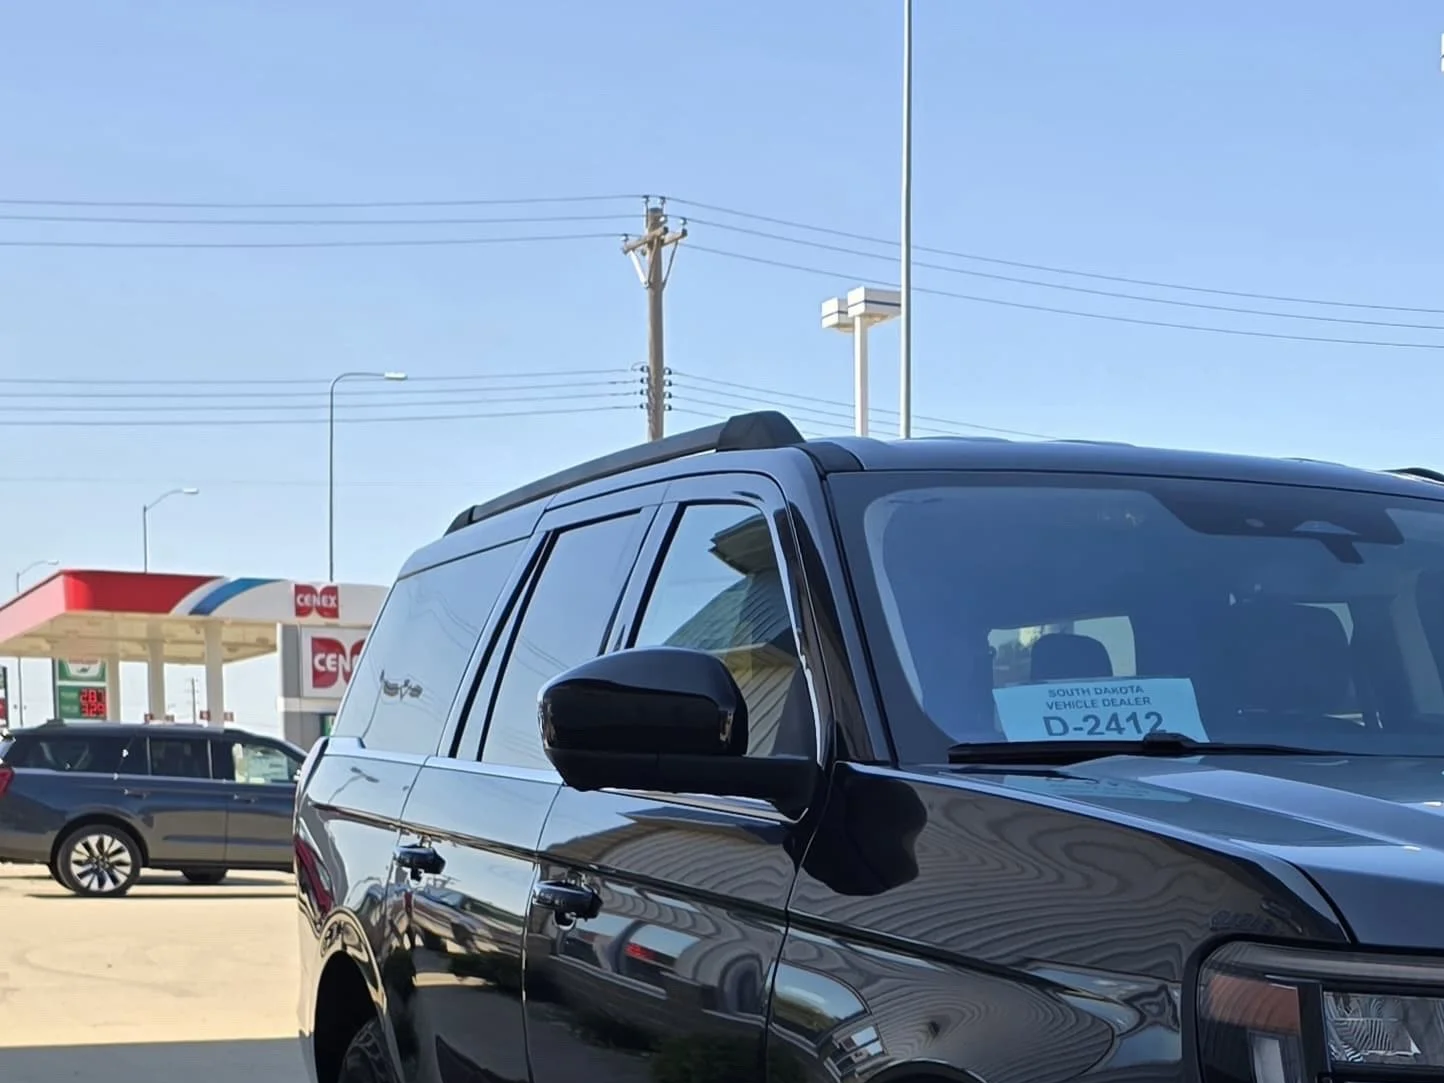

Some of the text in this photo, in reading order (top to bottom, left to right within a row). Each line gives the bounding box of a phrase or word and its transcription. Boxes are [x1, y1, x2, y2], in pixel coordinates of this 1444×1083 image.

[296, 593, 338, 608] CENEX
[313, 653, 361, 673] CEN
[1048, 685, 1144, 698] SOUTH DAKOTA
[1045, 696, 1152, 711] VEHICLE DEALER
[1042, 711, 1168, 737] D-2412
